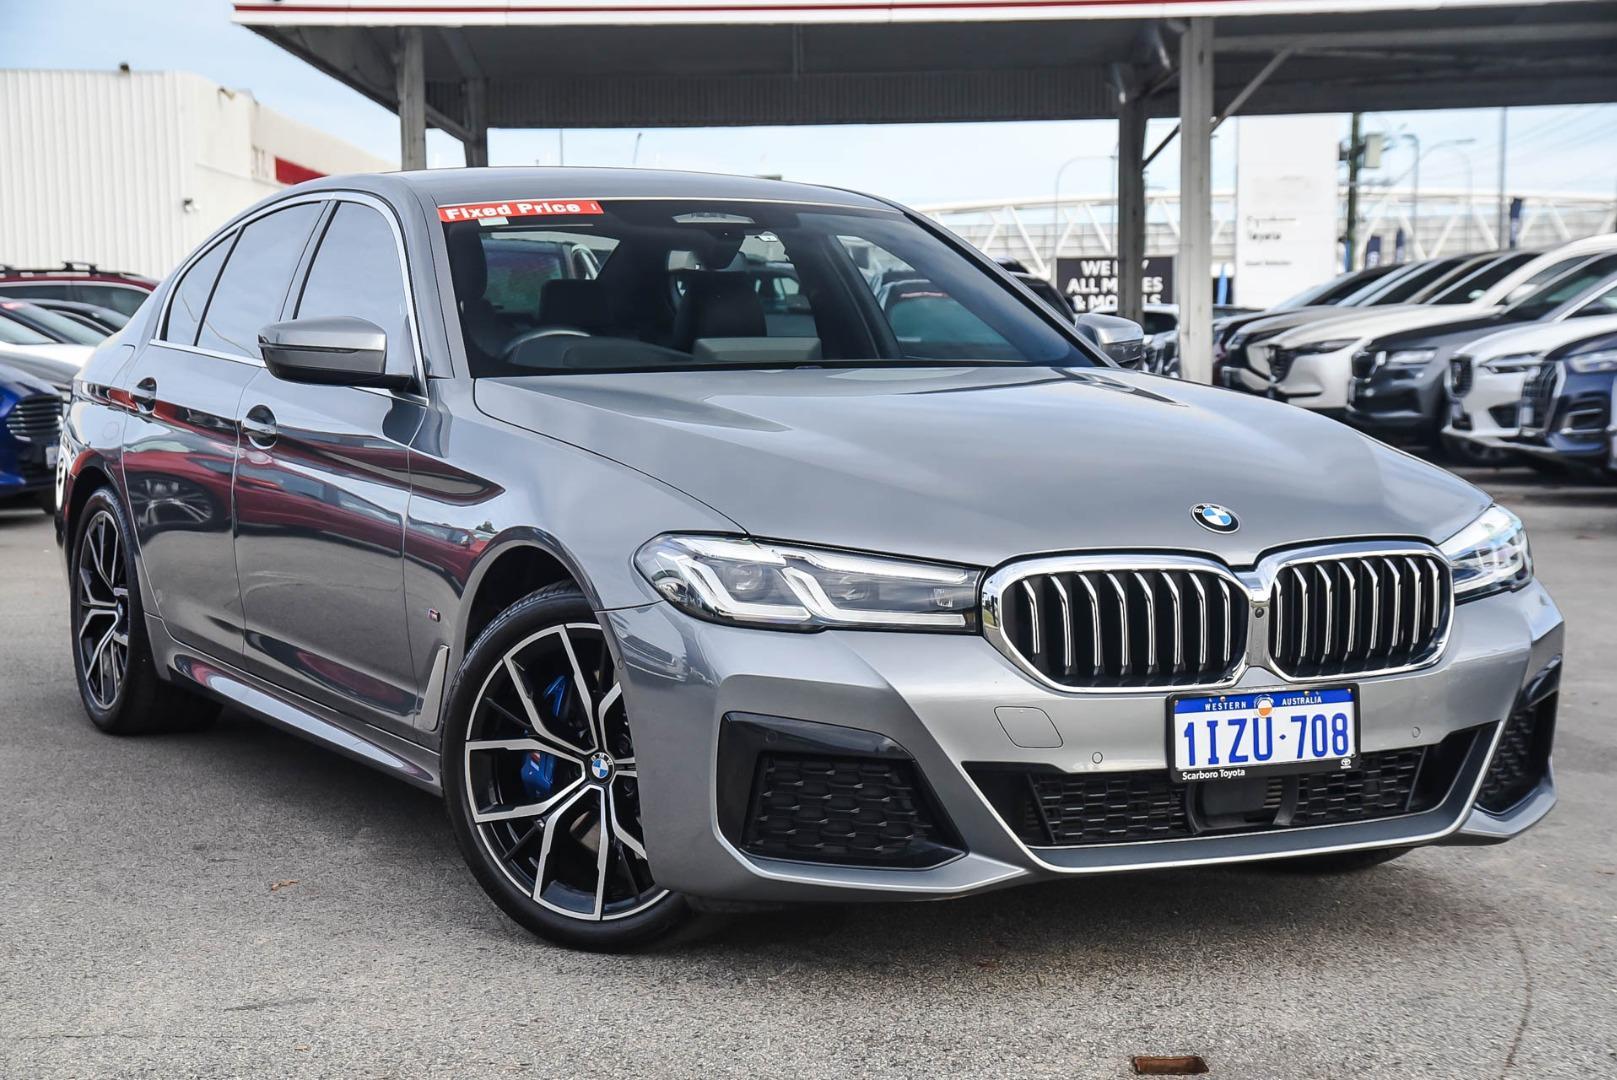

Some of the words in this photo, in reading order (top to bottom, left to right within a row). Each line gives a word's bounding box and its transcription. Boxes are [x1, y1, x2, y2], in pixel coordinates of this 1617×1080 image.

[445, 205, 513, 220] Fixed
[516, 202, 581, 214] Price
[1080, 260, 1111, 277] WE
[1066, 278, 1099, 294] ALL
[1101, 276, 1163, 294] MES
[1205, 701, 1247, 711] WESTERN
[1282, 696, 1322, 706] AUSTRALIA
[1182, 771, 1218, 780] Scarboro
[1219, 768, 1246, 779] Toyota
